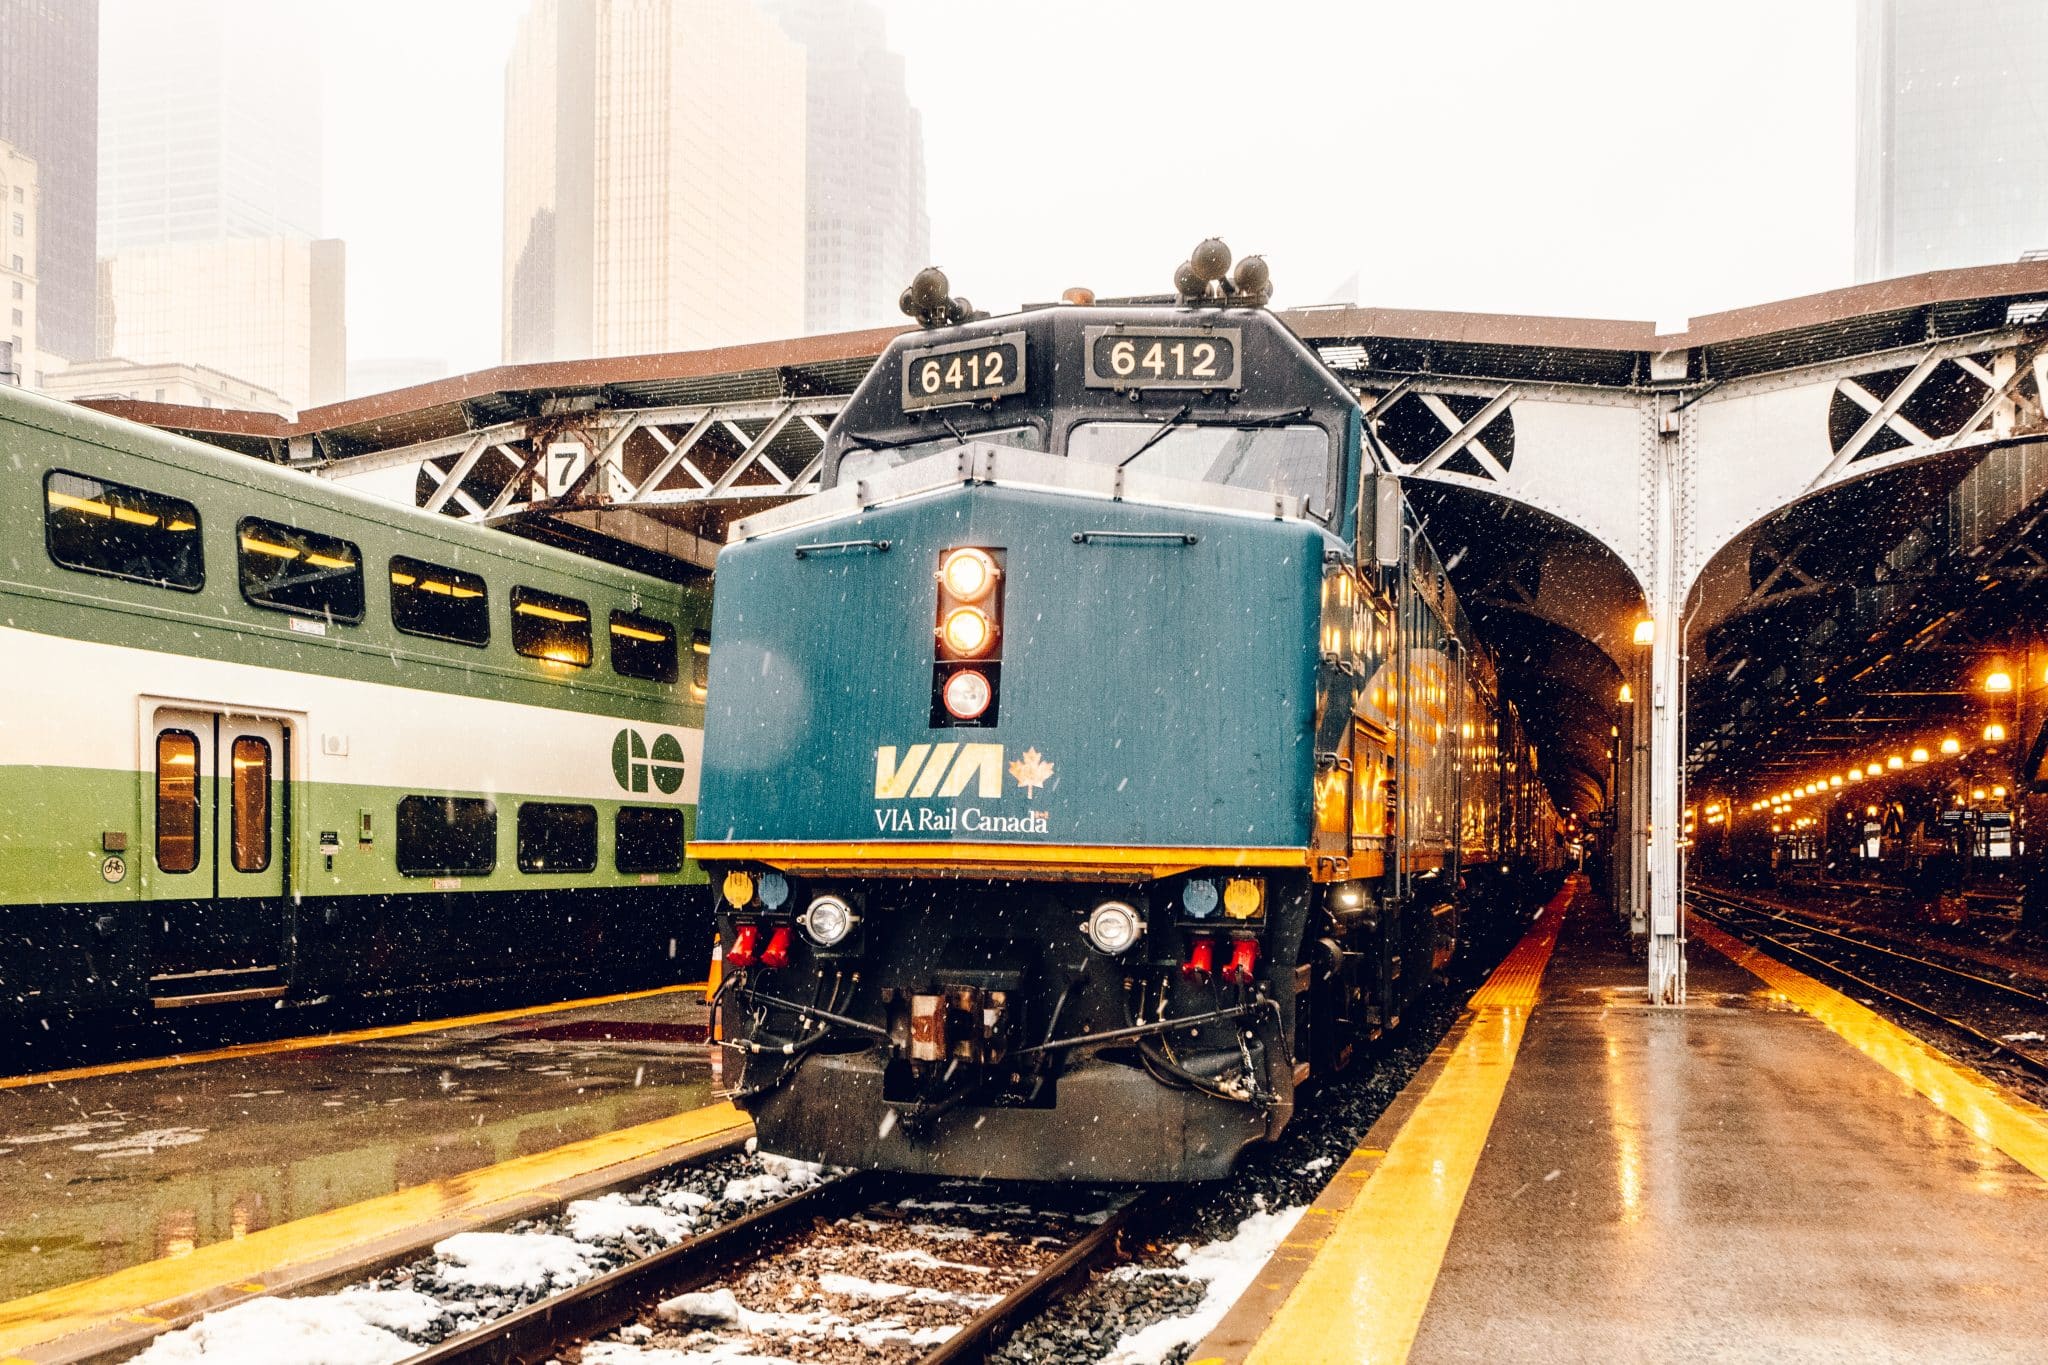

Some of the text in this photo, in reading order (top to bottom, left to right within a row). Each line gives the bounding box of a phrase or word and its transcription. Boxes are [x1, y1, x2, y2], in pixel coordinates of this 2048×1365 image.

[921, 351, 1003, 393] 6412
[1111, 341, 1216, 376] 6412
[554, 452, 578, 486] 7
[611, 727, 685, 795] GO
[874, 742, 1004, 799] VIA
[874, 806, 1049, 834] VIA Rail Canada
